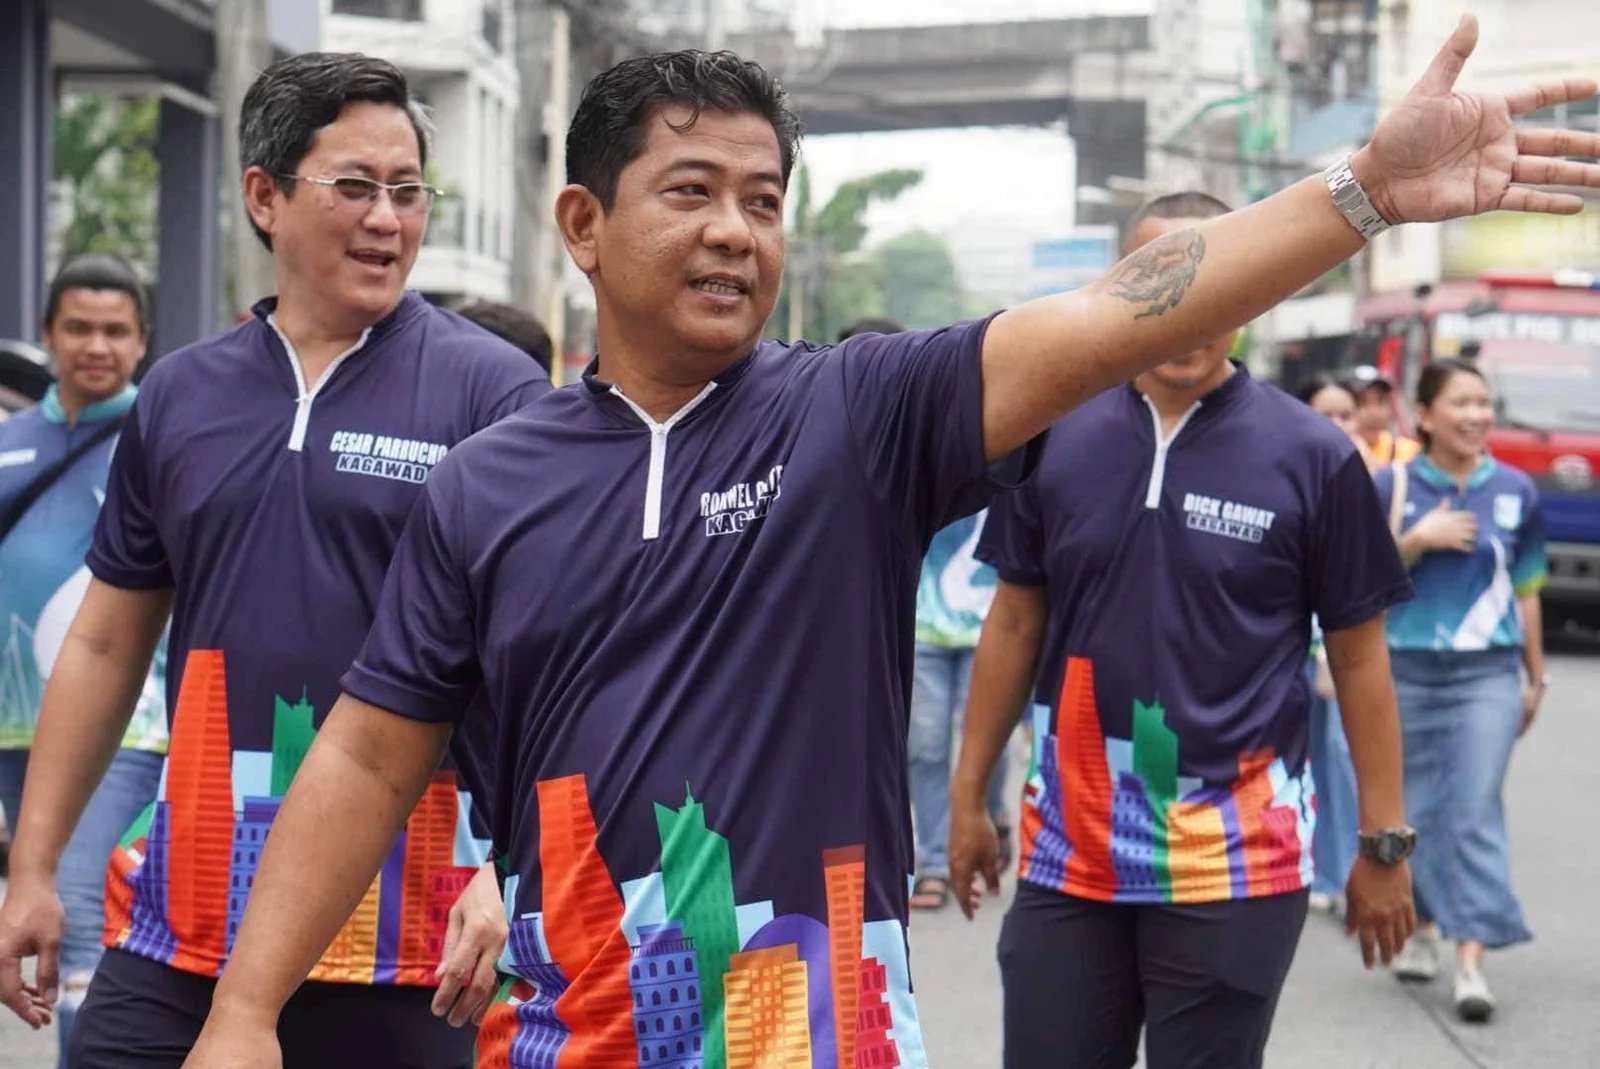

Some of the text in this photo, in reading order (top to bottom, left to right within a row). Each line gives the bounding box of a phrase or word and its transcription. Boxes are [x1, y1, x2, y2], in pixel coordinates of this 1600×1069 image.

[330, 431, 374, 455] CESAR
[338, 455, 427, 483] KAGAWAD
[1183, 492, 1221, 517] DICK
